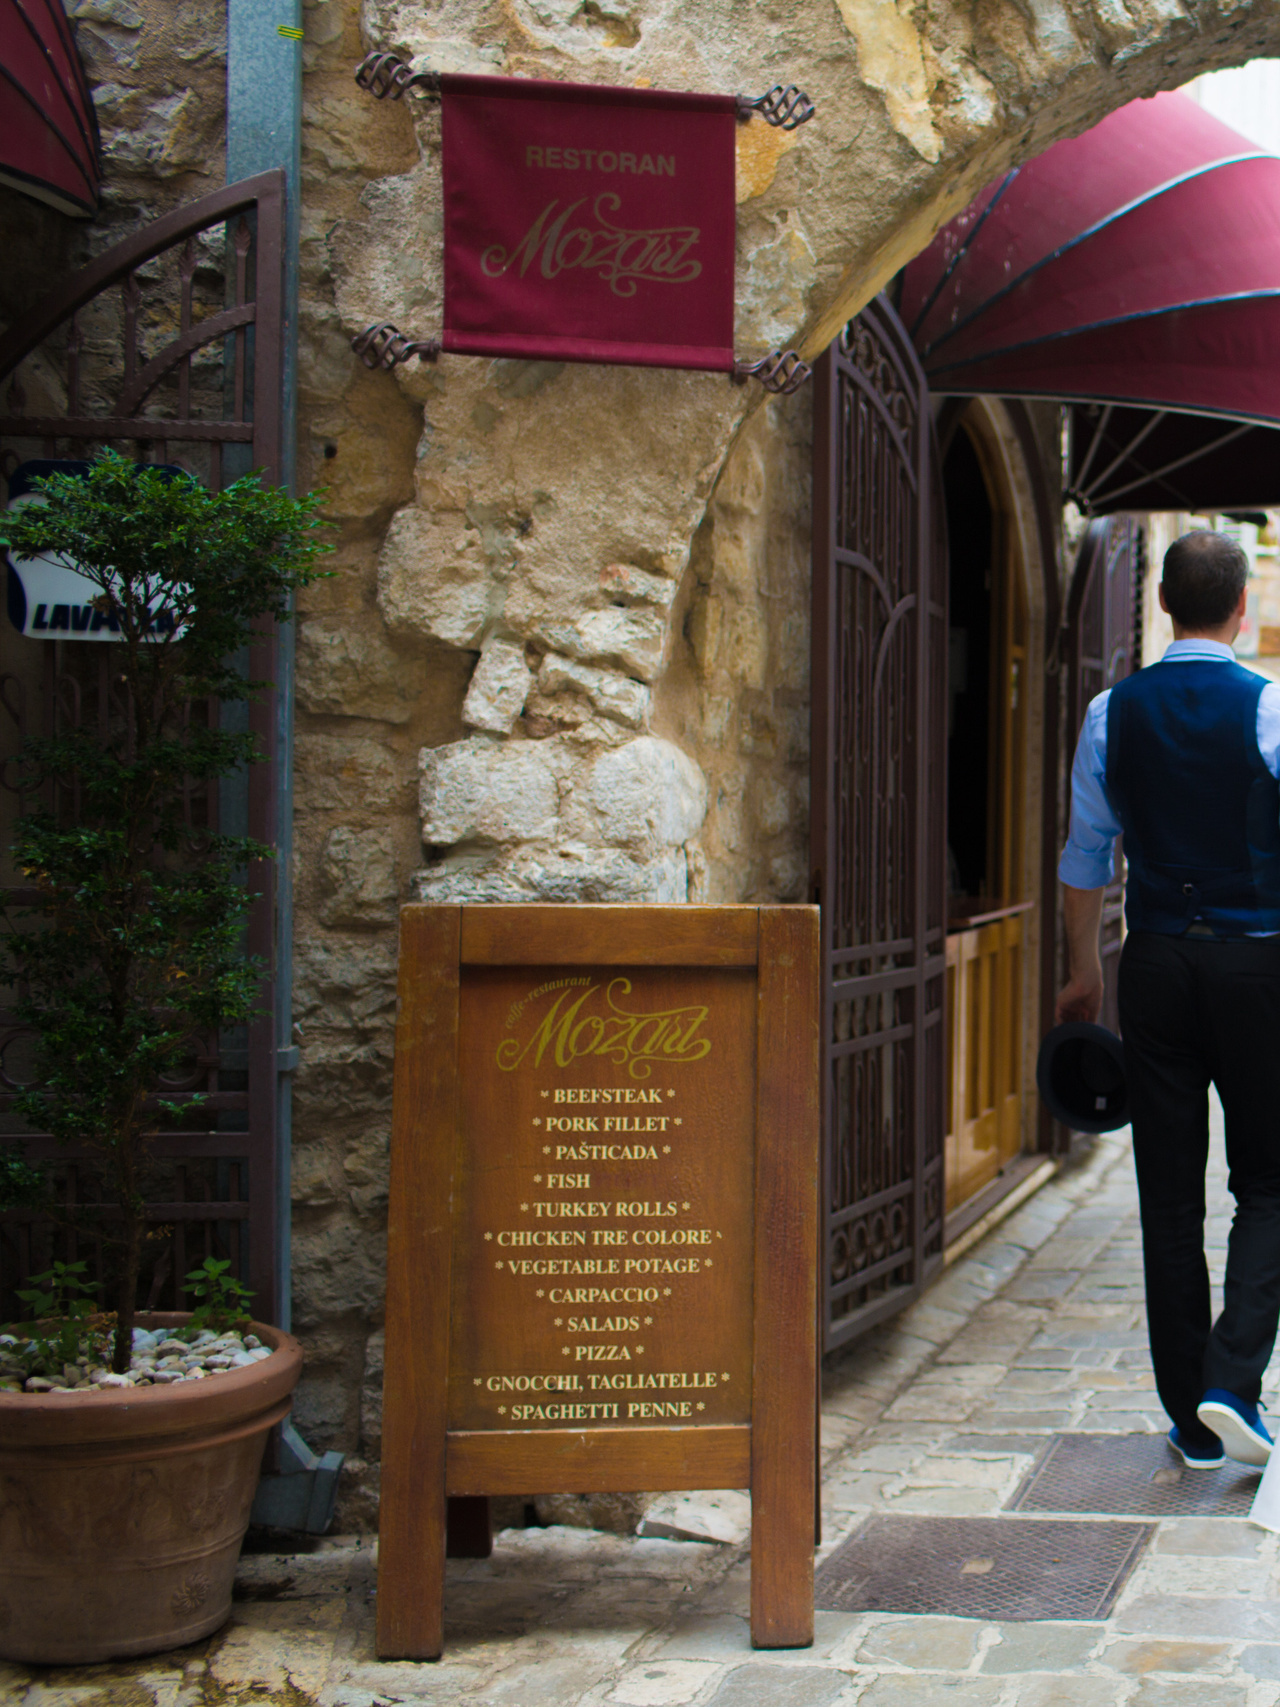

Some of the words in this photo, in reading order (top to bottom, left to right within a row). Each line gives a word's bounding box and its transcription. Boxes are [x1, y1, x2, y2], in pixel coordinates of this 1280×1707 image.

[526, 146, 676, 177] RESTORAN
[480, 192, 703, 298] Mozart
[32, 603, 177, 633] LAVAA
[496, 977, 712, 1080] Mozart
[553, 1088, 662, 1104] BEEFSTEAK
[546, 1117, 599, 1132] PORK
[603, 1117, 670, 1132] FILLET
[555, 1142, 659, 1160] PAŠTICADA
[547, 1174, 590, 1189] FISH
[533, 1202, 612, 1218] TURKEY
[615, 1202, 678, 1217] ROLLS
[497, 1231, 586, 1247] CHICKEN
[591, 1230, 628, 1246] TRE
[632, 1230, 712, 1245] COLORE
[508, 1259, 619, 1275] VEGETABLE
[624, 1258, 700, 1274] POTAGE
[549, 1287, 659, 1303] CARPACCIO
[567, 1317, 640, 1332] SALADS
[575, 1346, 632, 1361] PIZZA
[486, 1375, 584, 1392] GNOCCHI,
[587, 1373, 717, 1390] TAGLIATELLE
[511, 1404, 618, 1420] SPAGHETTI
[628, 1402, 692, 1418] PENNE
